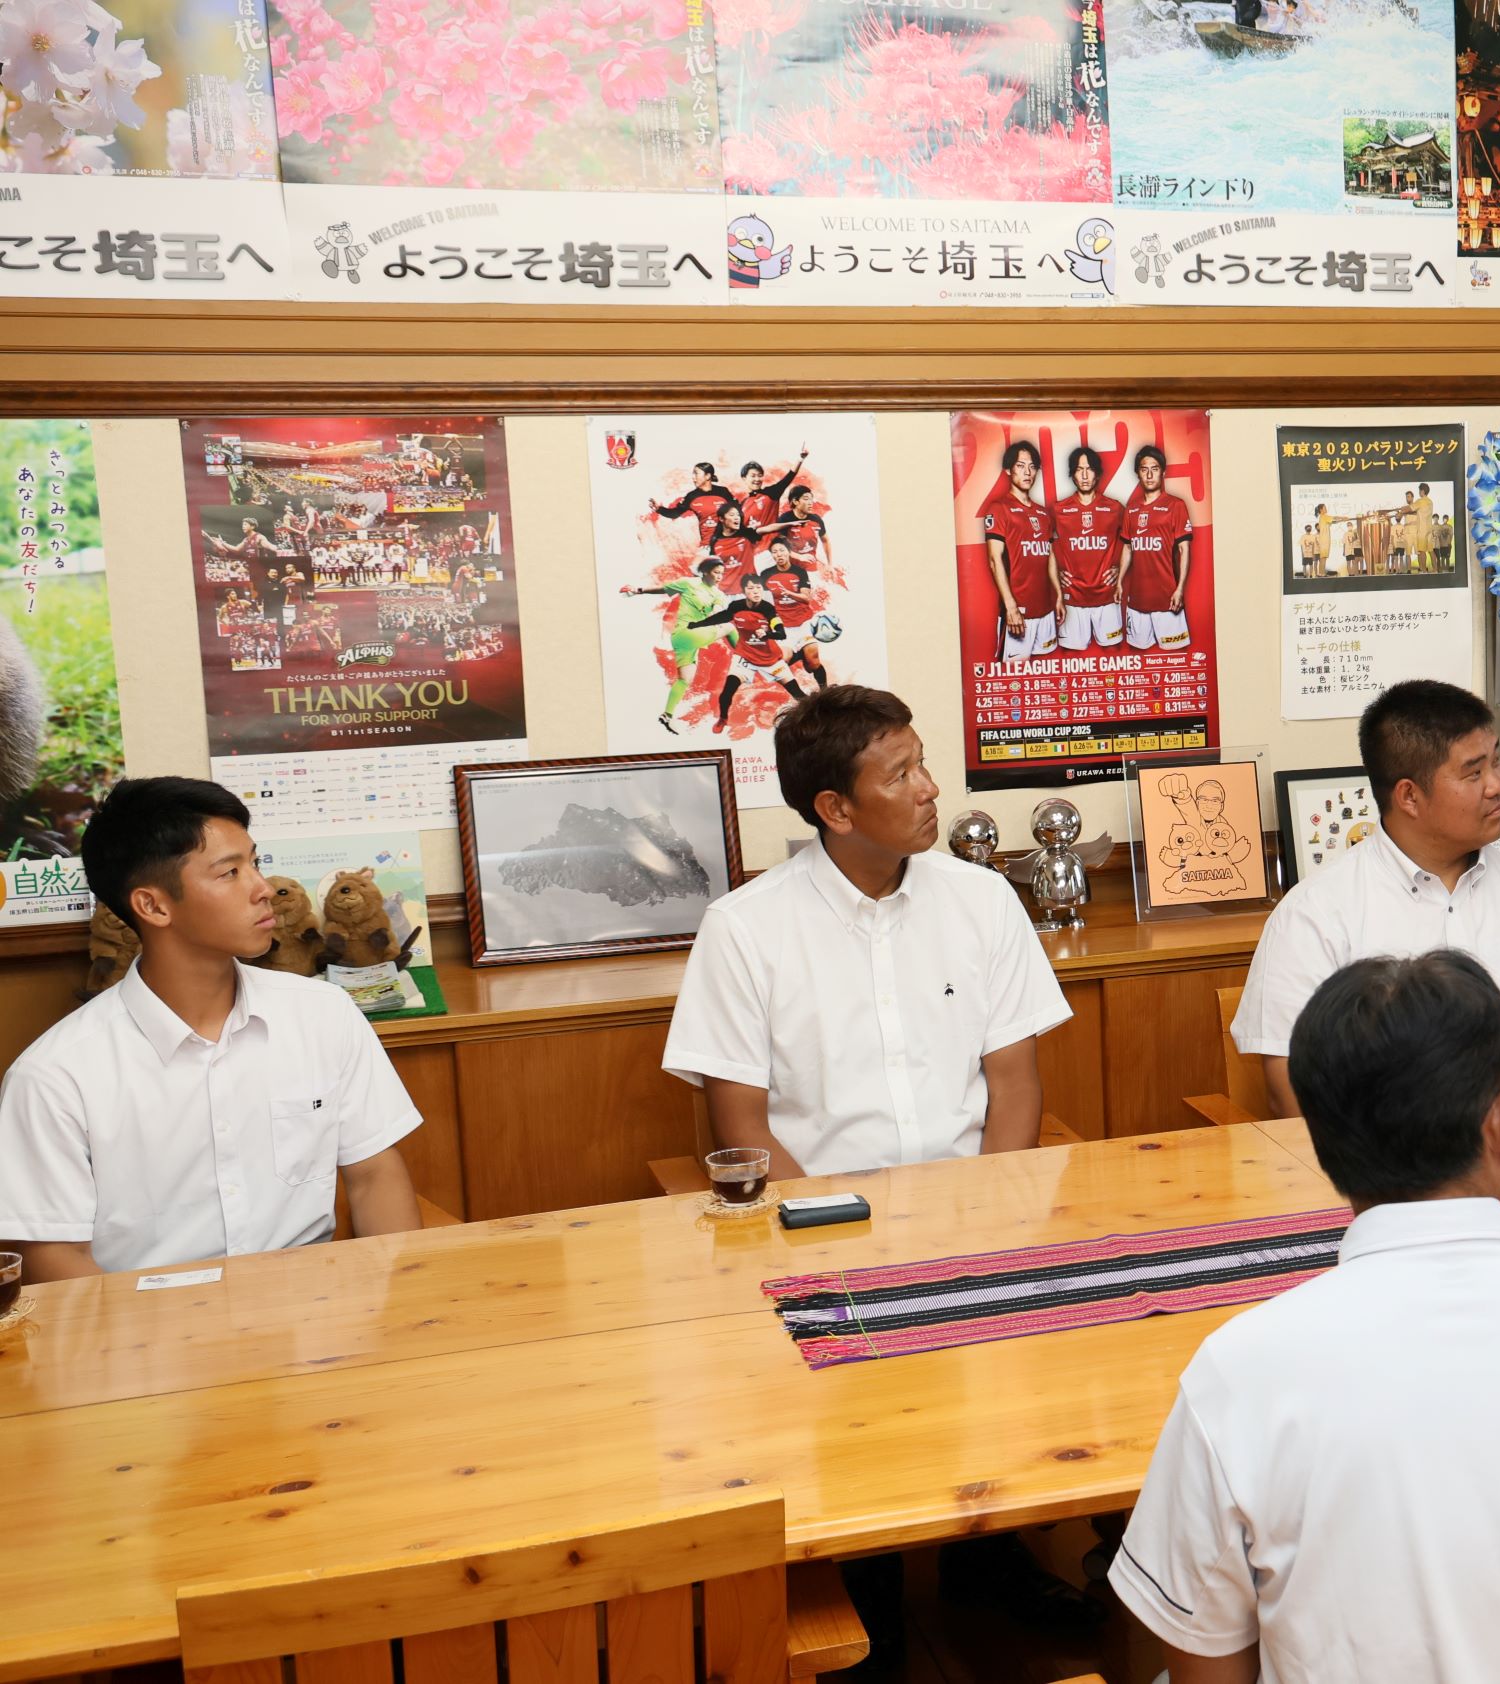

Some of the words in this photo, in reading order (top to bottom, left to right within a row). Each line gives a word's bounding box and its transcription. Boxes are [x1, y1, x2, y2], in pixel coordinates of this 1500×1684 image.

[368, 214, 426, 246] WELCOME
[427, 208, 445, 226] TO
[445, 202, 500, 220] SAITAMA
[820, 216, 915, 233] WELCOME
[920, 218, 945, 233] TO
[949, 218, 1031, 235] SAITAMA
[1172, 227, 1218, 254] WELCOME
[1219, 223, 1232, 237] TO
[1234, 216, 1276, 232] SAITAMA
[383, 241, 713, 288] ようこそ埼玉へ
[799, 240, 1065, 281] ようこそ埼玉へ
[1183, 250, 1444, 292] ようこそ埼玉へ
[1282, 439, 1459, 457] 東京2020パラリンピック
[1317, 455, 1427, 472] 聖火リレートーチ
[50, 450, 68, 569] きっとみつかる
[18, 467, 39, 613] あなたの友だち！
[1069, 536, 1108, 551] POLUS
[1293, 603, 1337, 615] デザイン
[1299, 611, 1449, 626] 日本人になじみの深い花である桜がモチーフ
[1165, 632, 1188, 643] DHL
[1299, 623, 1420, 635] 継ぎ目のないひとつなぎのデザイン
[338, 645, 394, 667] ALPHAS
[1296, 640, 1361, 654] トーチの仕様
[987, 659, 1060, 678] J1.LEAGUE
[1062, 657, 1097, 674] HOME
[1099, 655, 1142, 672] GAMES
[1146, 657, 1163, 665] March
[1167, 656, 1186, 665] August
[286, 668, 446, 682] たくさんのご支援・ご声援ありがとうございました
[976, 683, 992, 693] 3.2
[1023, 680, 1040, 691] 3.8
[1071, 678, 1087, 688] 4.2
[1118, 675, 1135, 686] 4.16
[1164, 672, 1181, 683] 4.20
[264, 683, 391, 714] THANK
[394, 679, 469, 708] YOU
[976, 697, 993, 708] 4.25
[1024, 695, 1040, 705] 5.3
[1072, 692, 1088, 703] 5.6
[1118, 690, 1135, 700] 5.17
[1164, 687, 1181, 698] 5.28
[301, 714, 329, 726] FOR
[332, 711, 372, 724] YOUR
[375, 708, 439, 723] SUPPORT
[977, 712, 992, 723] 6.1
[1024, 710, 1042, 720] 7.23
[1072, 707, 1088, 717] 7.27
[1119, 704, 1136, 715] 8.16
[1165, 702, 1181, 712] 8.31
[367, 726, 412, 735] SEASON
[980, 730, 999, 741] FIFA
[1000, 729, 1021, 740] CLUB
[1023, 727, 1053, 738] WORLD
[1055, 726, 1071, 736] CUP
[1072, 725, 1091, 735] 2025
[736, 766, 747, 774] ED
[752, 765, 778, 773] DIAM
[1077, 768, 1104, 777] URAWA
[736, 775, 765, 783] ADIES
[1181, 867, 1233, 882] SAITAMA
